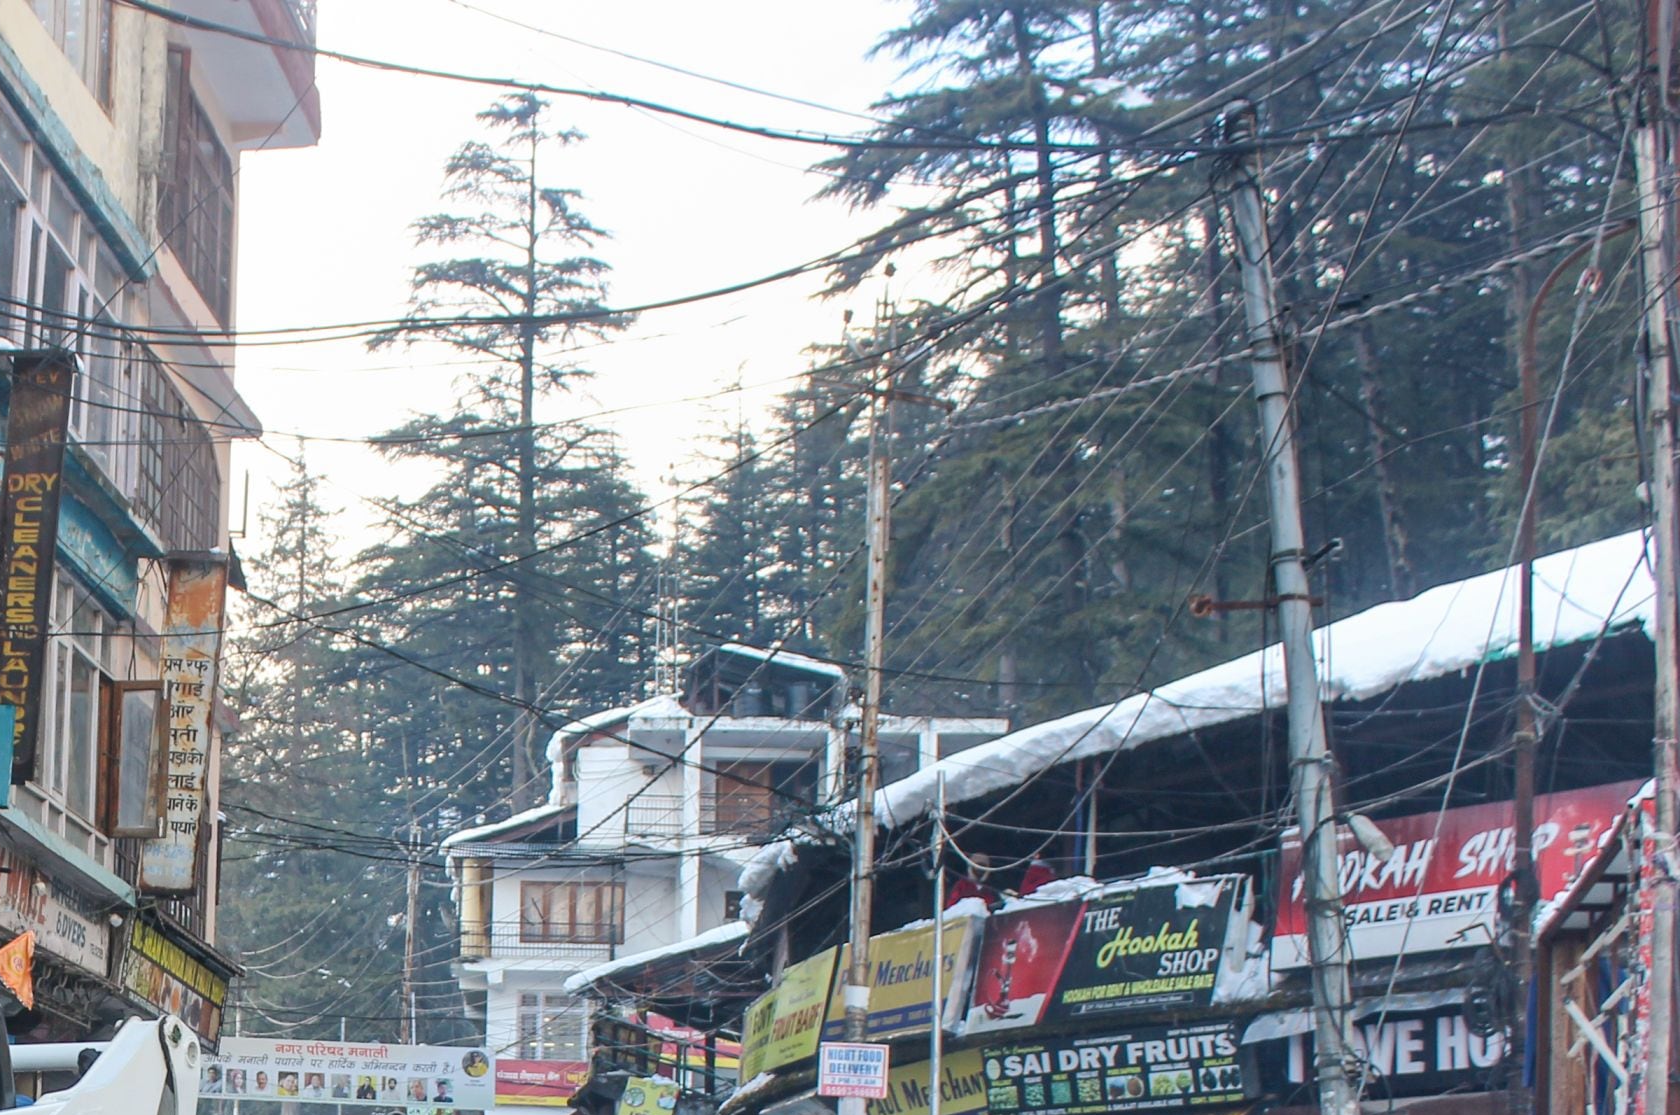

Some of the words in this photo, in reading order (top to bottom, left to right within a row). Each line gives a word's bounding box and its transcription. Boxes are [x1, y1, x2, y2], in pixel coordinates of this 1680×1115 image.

[7, 472, 58, 494] DRY
[6, 496, 43, 623] CLEANERS
[1084, 907, 1122, 933] THE
[1345, 904, 1397, 927] SALE
[1405, 901, 1420, 918] &
[1427, 891, 1489, 915] RENT
[1096, 918, 1198, 969] Hookah
[1157, 948, 1219, 976] SHOP
[238, 1054, 268, 1066] मनाली
[311, 1058, 322, 1067] पर
[328, 1058, 355, 1071] हार्दिक
[275, 1043, 302, 1055] नगर
[307, 1042, 344, 1056] परिषद
[348, 1044, 389, 1058] मनाली
[858, 1050, 882, 1062] FOOD
[1004, 1052, 1051, 1077] SAI
[1058, 1045, 1119, 1072] DRY
[1126, 1032, 1237, 1065] FRUITS
[829, 1062, 880, 1075] DELIVERY
